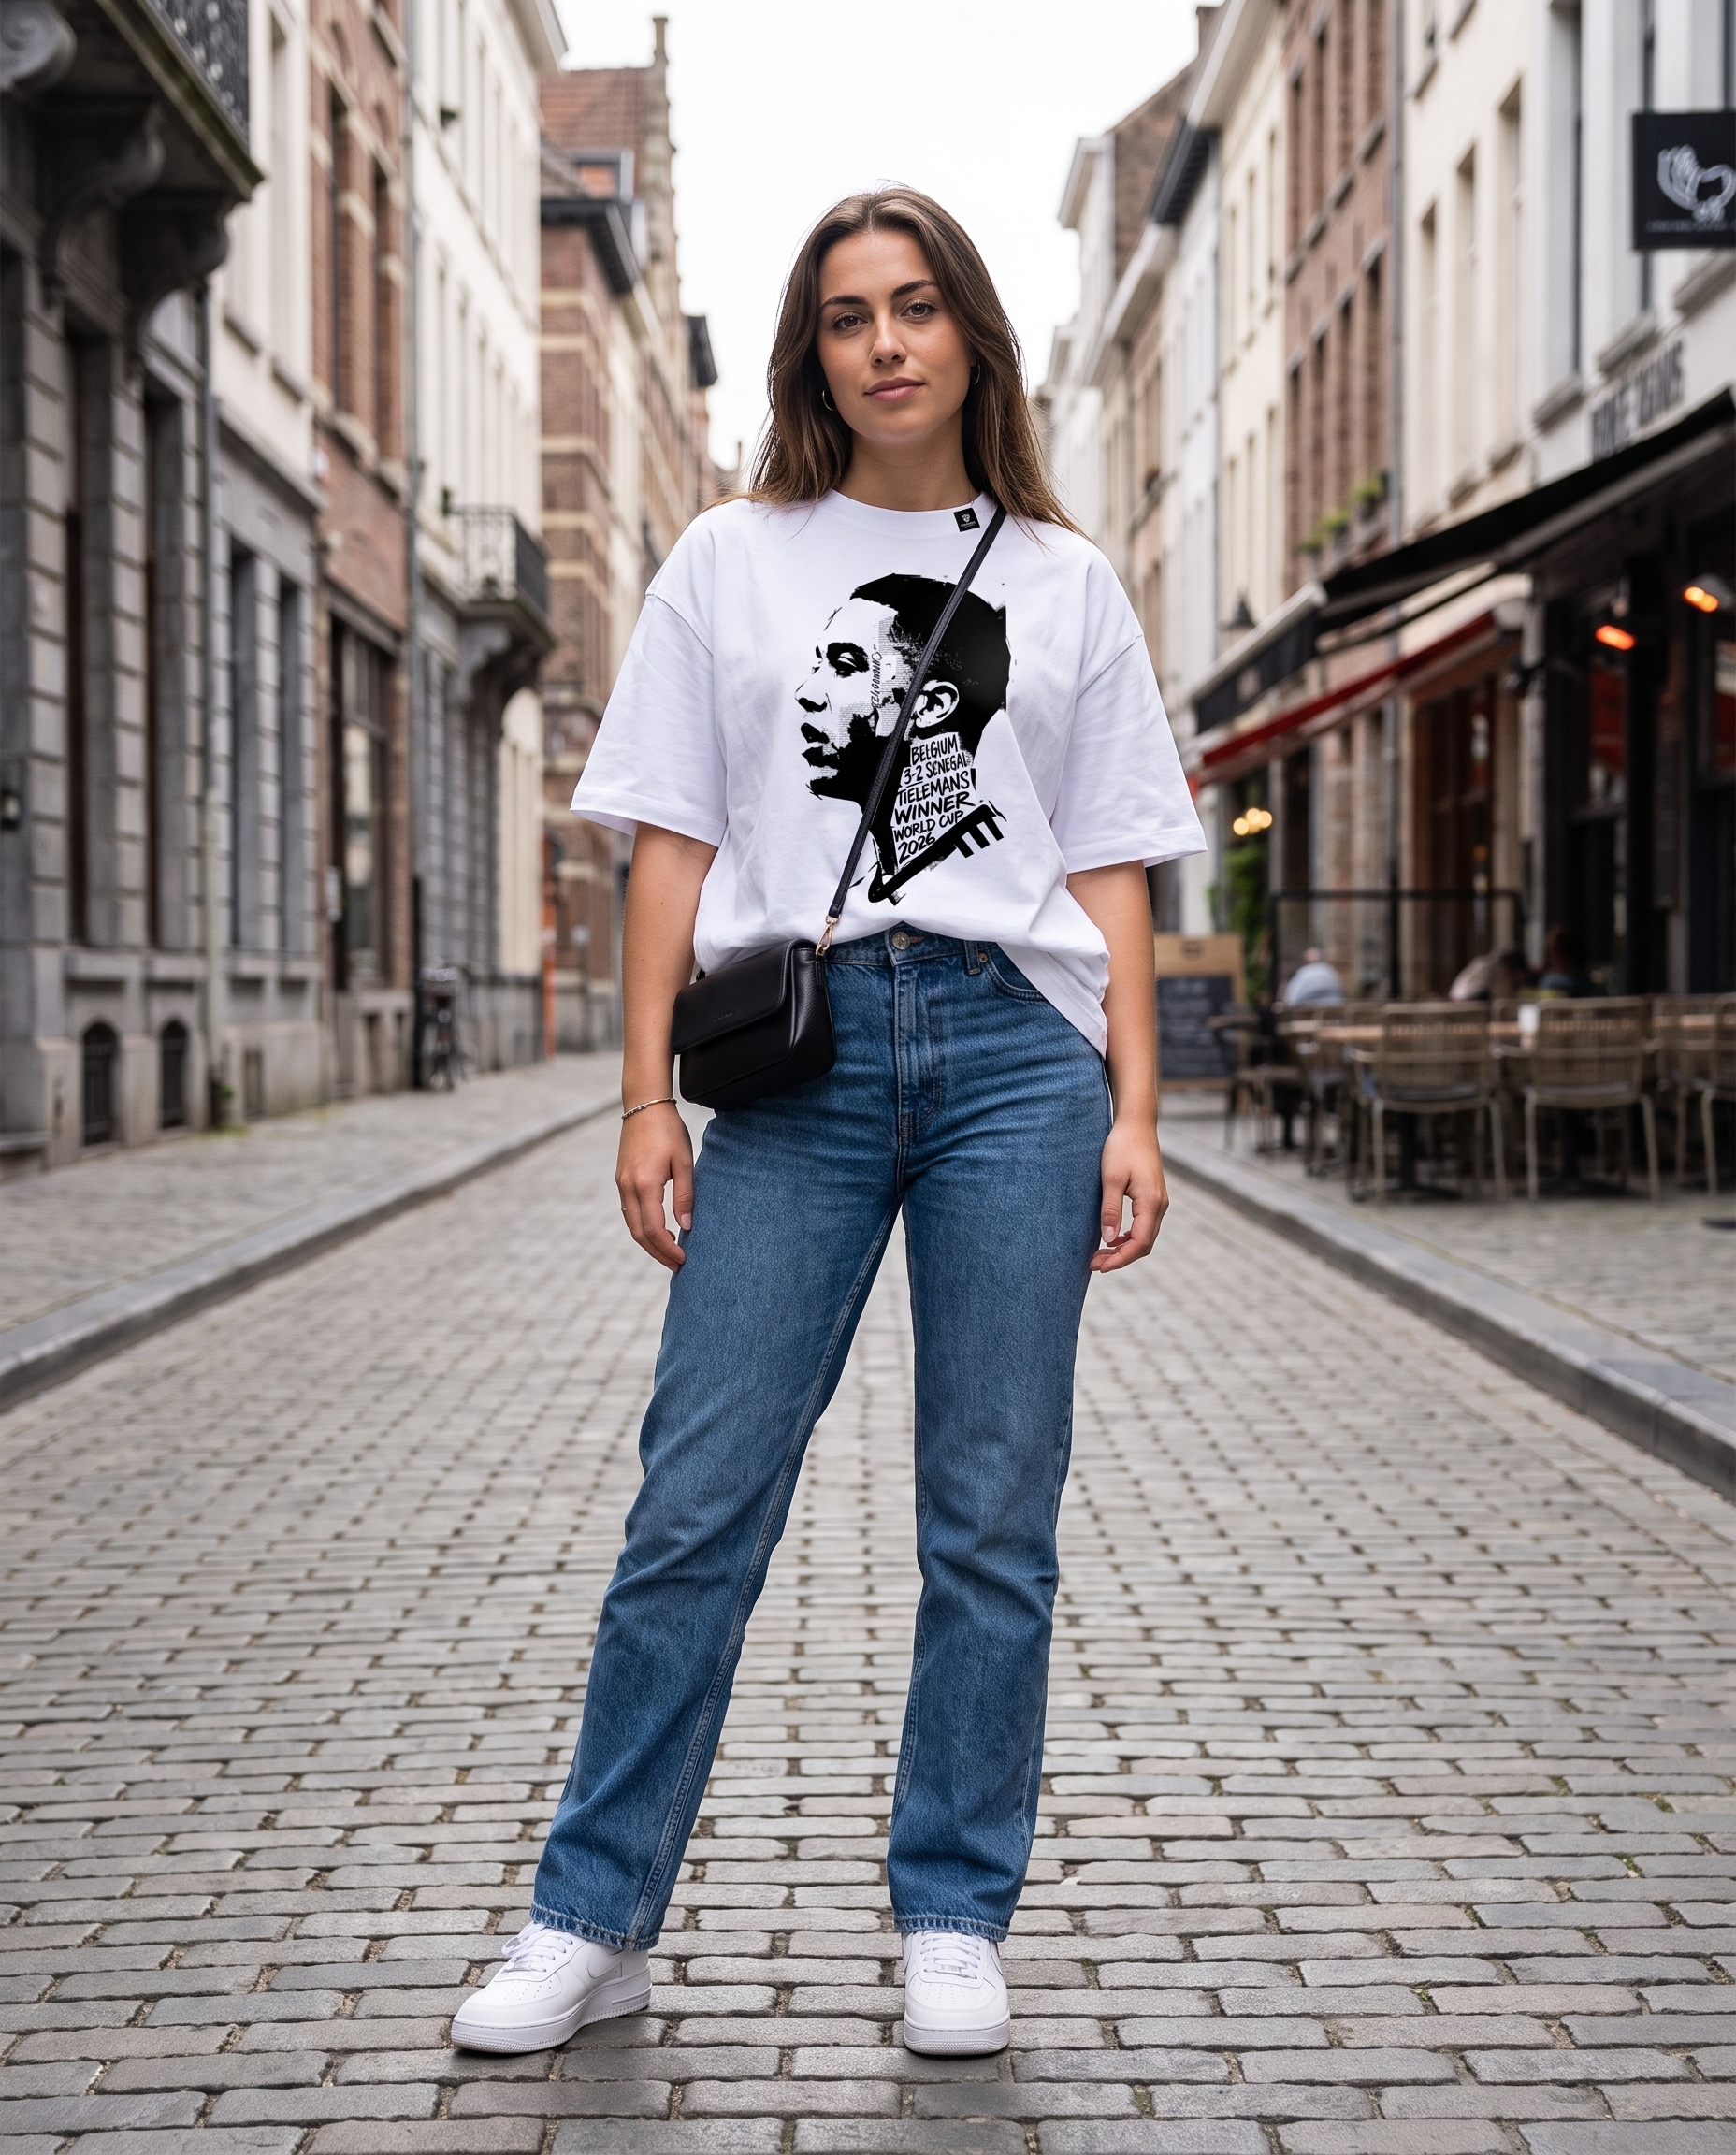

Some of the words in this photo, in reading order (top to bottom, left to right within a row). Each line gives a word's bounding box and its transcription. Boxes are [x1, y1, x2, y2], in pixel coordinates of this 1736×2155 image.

[911, 734, 958, 766] BELGIUM
[904, 765, 924, 786] 3-2
[925, 752, 968, 778] SENEGAL
[897, 771, 970, 806] TIELEMANS
[894, 791, 976, 825] WINNER
[893, 818, 936, 843] WORLD
[939, 810, 964, 828] CUP
[898, 832, 936, 865] 2026
